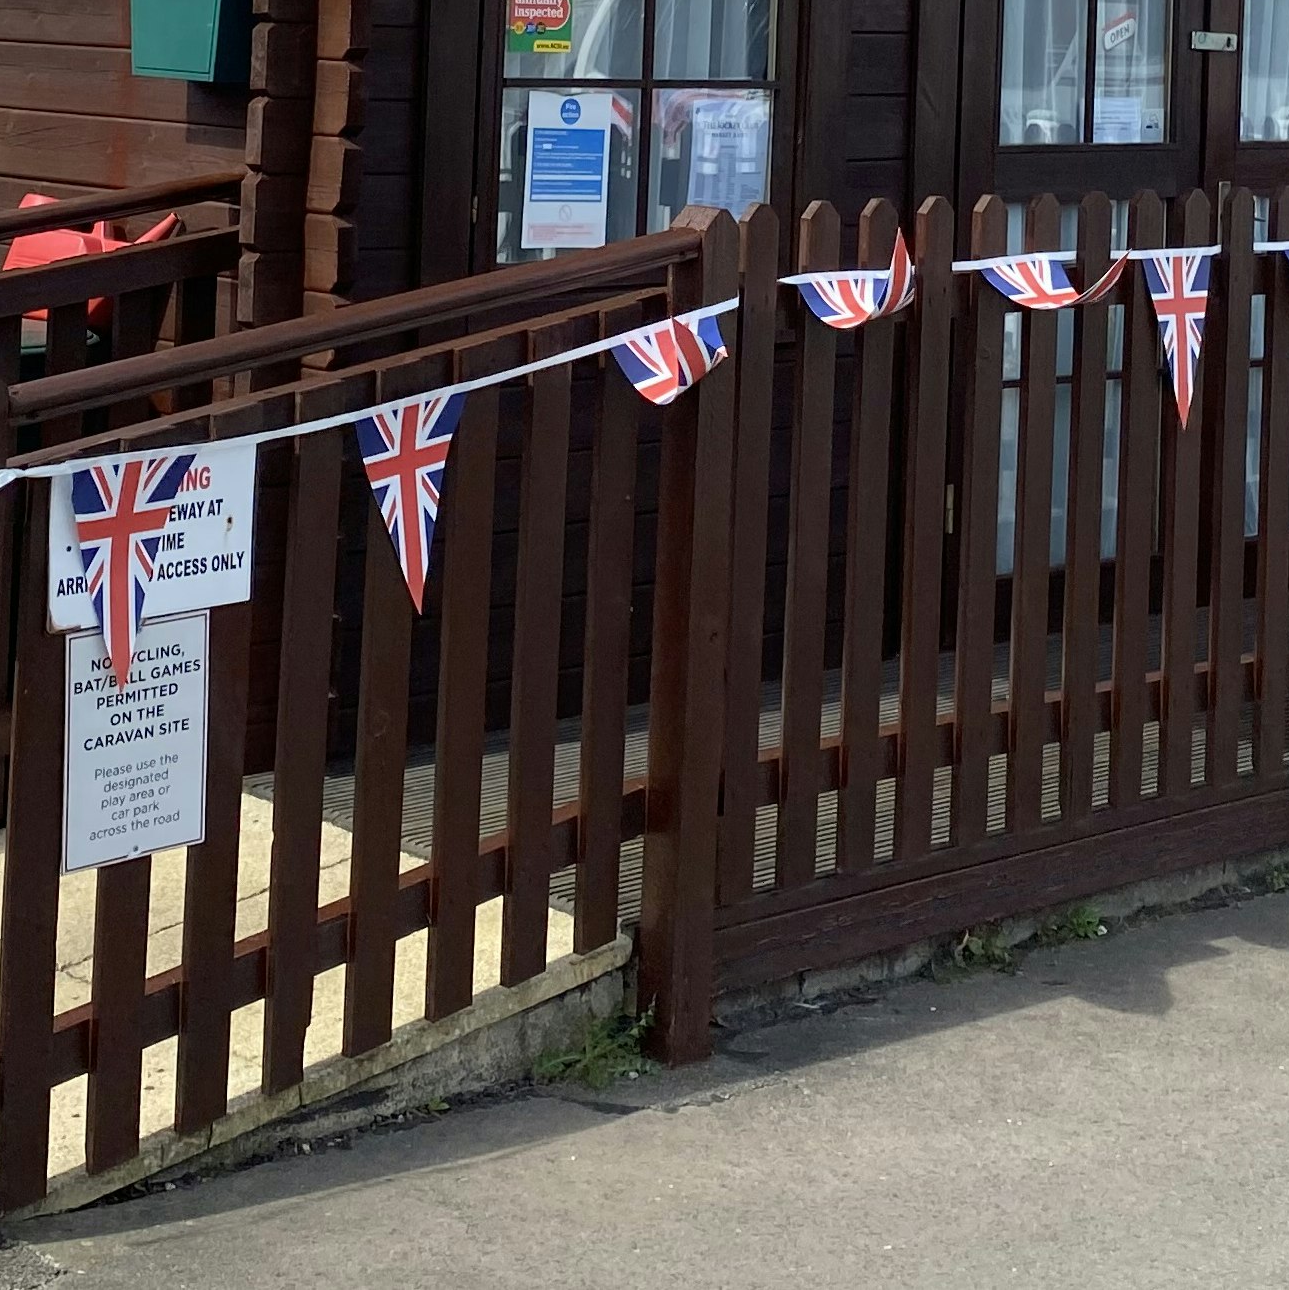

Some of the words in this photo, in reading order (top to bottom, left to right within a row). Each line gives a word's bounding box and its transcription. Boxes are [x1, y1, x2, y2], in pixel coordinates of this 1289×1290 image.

[515, 6, 564, 19] inspected
[1110, 24, 1130, 44] OPEN
[168, 499, 205, 523] EWAY
[207, 499, 223, 516] AT
[161, 532, 185, 552] IME
[56, 576, 88, 597] ARRI
[157, 557, 207, 581] ACCESS
[212, 551, 245, 571] ONLY
[74, 670, 146, 695] BAT/BLL
[151, 659, 201, 679] GAMES
[91, 657, 112, 672] NO
[97, 683, 178, 710] PERMITTED
[110, 711, 132, 726] ON
[137, 704, 165, 721] THE
[84, 725, 154, 751] CARAVAN
[159, 718, 190, 735] SITE
[94, 764, 132, 780] Please
[136, 759, 156, 771] use
[160, 754, 179, 765] the
[103, 768, 169, 793] designated
[101, 795, 125, 810] play
[129, 789, 155, 802] area
[158, 784, 171, 795] or
[111, 808, 130, 821] car
[133, 800, 160, 817] park
[90, 824, 127, 841] across
[130, 819, 150, 831] the
[153, 810, 180, 826] road
